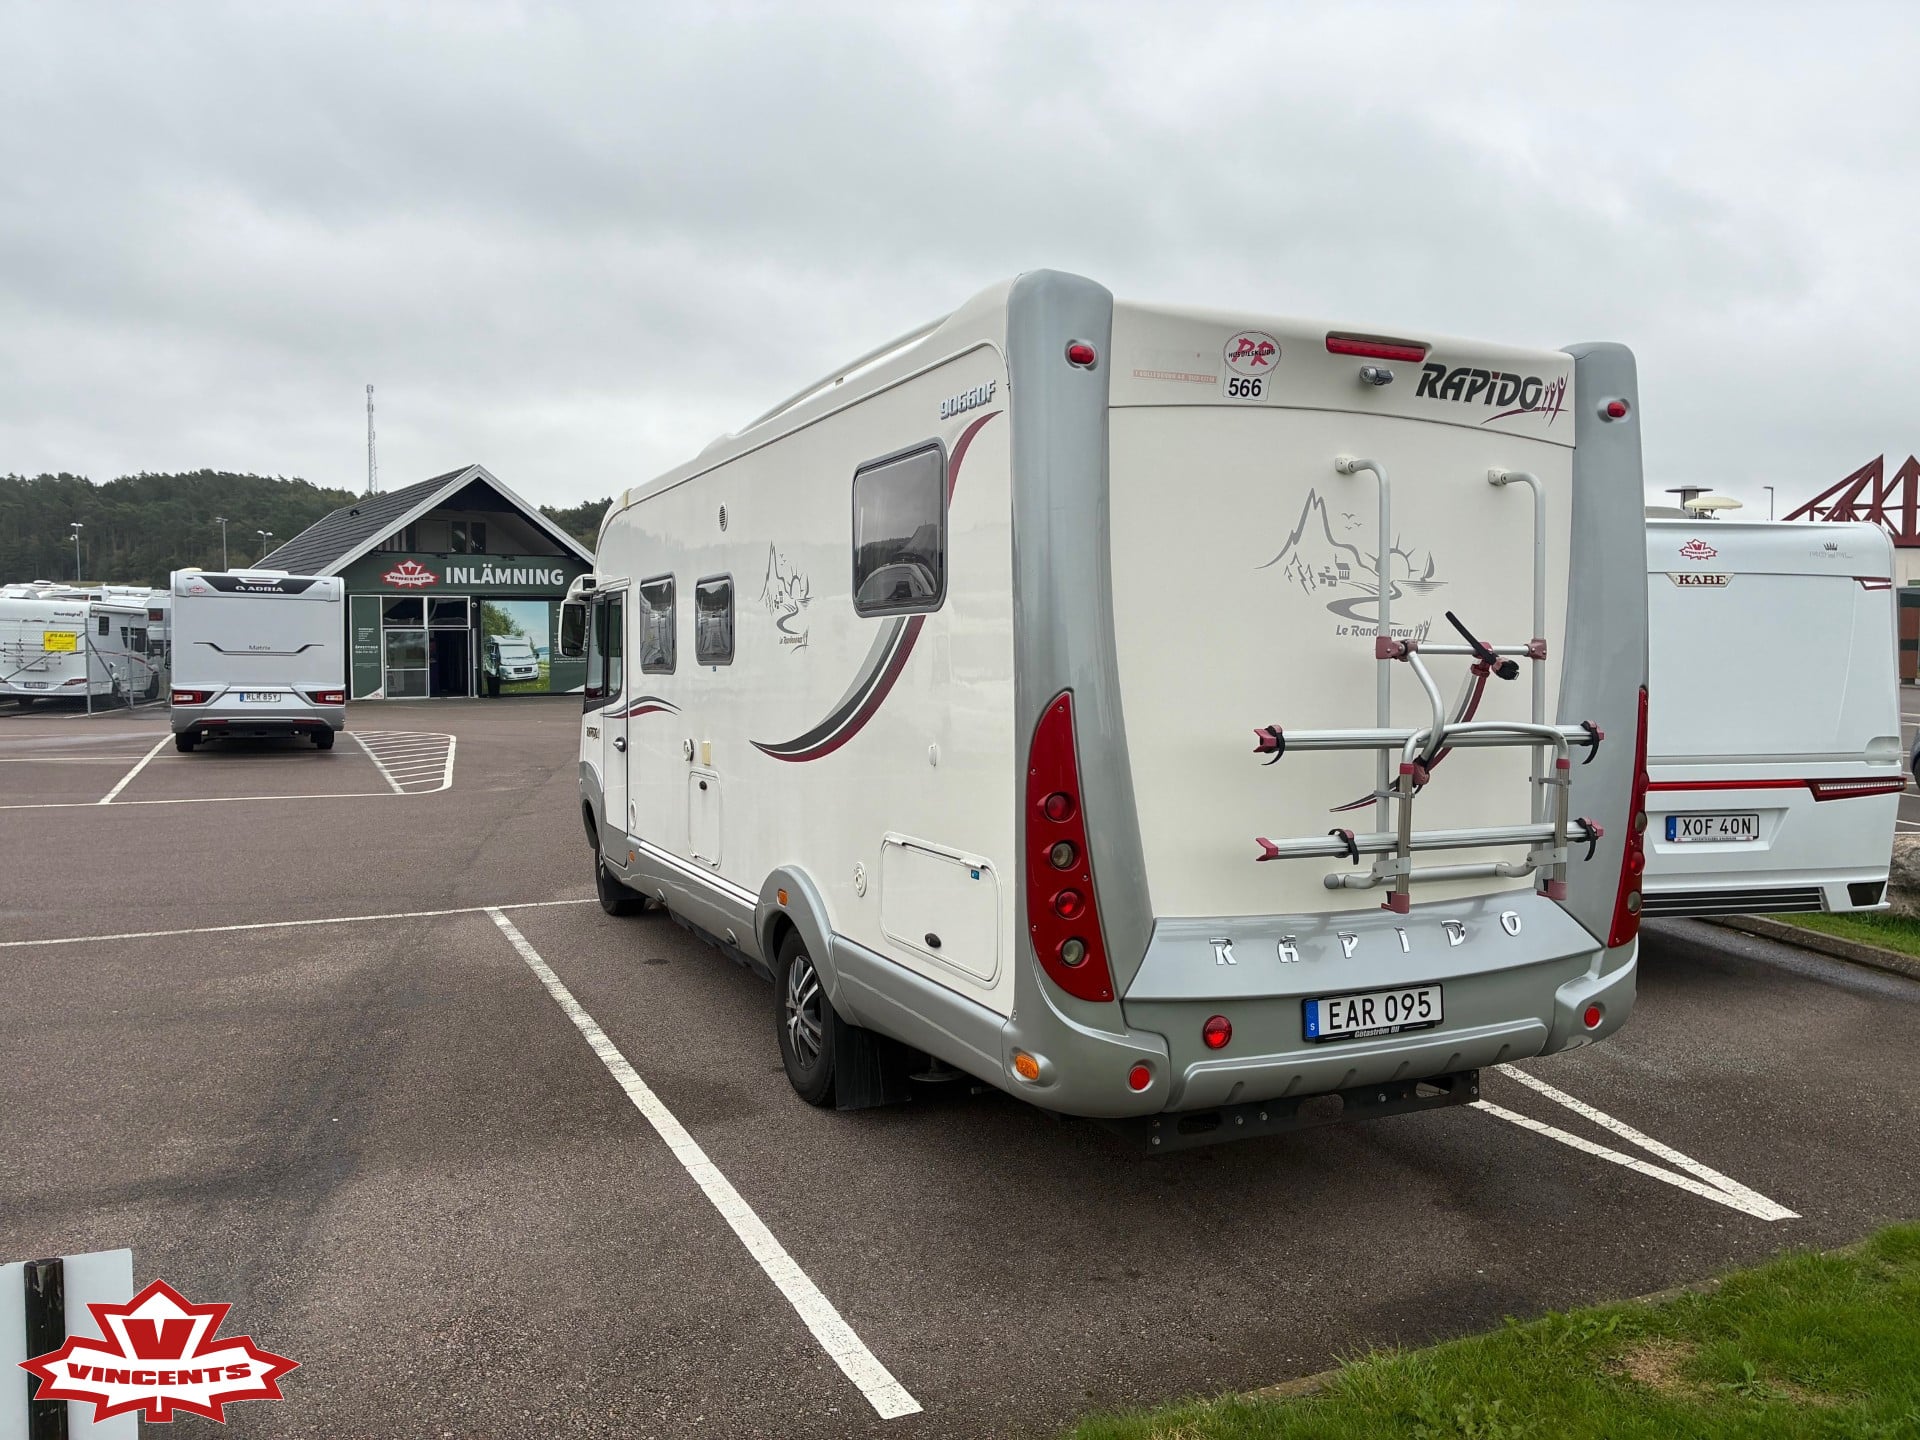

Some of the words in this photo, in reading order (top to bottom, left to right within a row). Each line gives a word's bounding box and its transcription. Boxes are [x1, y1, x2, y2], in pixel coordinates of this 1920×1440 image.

[1228, 378, 1262, 398] 566
[445, 563, 564, 586] INLÄMNING
[1677, 574, 1727, 585] KABE
[1336, 625, 1348, 636] Le
[1351, 625, 1413, 637] Randneur
[1682, 818, 1714, 836] XOF
[1719, 817, 1751, 834] 40N
[1209, 910, 1522, 965] RAPIDO
[1329, 998, 1376, 1031] EAR
[1385, 991, 1431, 1023] 095
[1310, 1023, 1316, 1031] S
